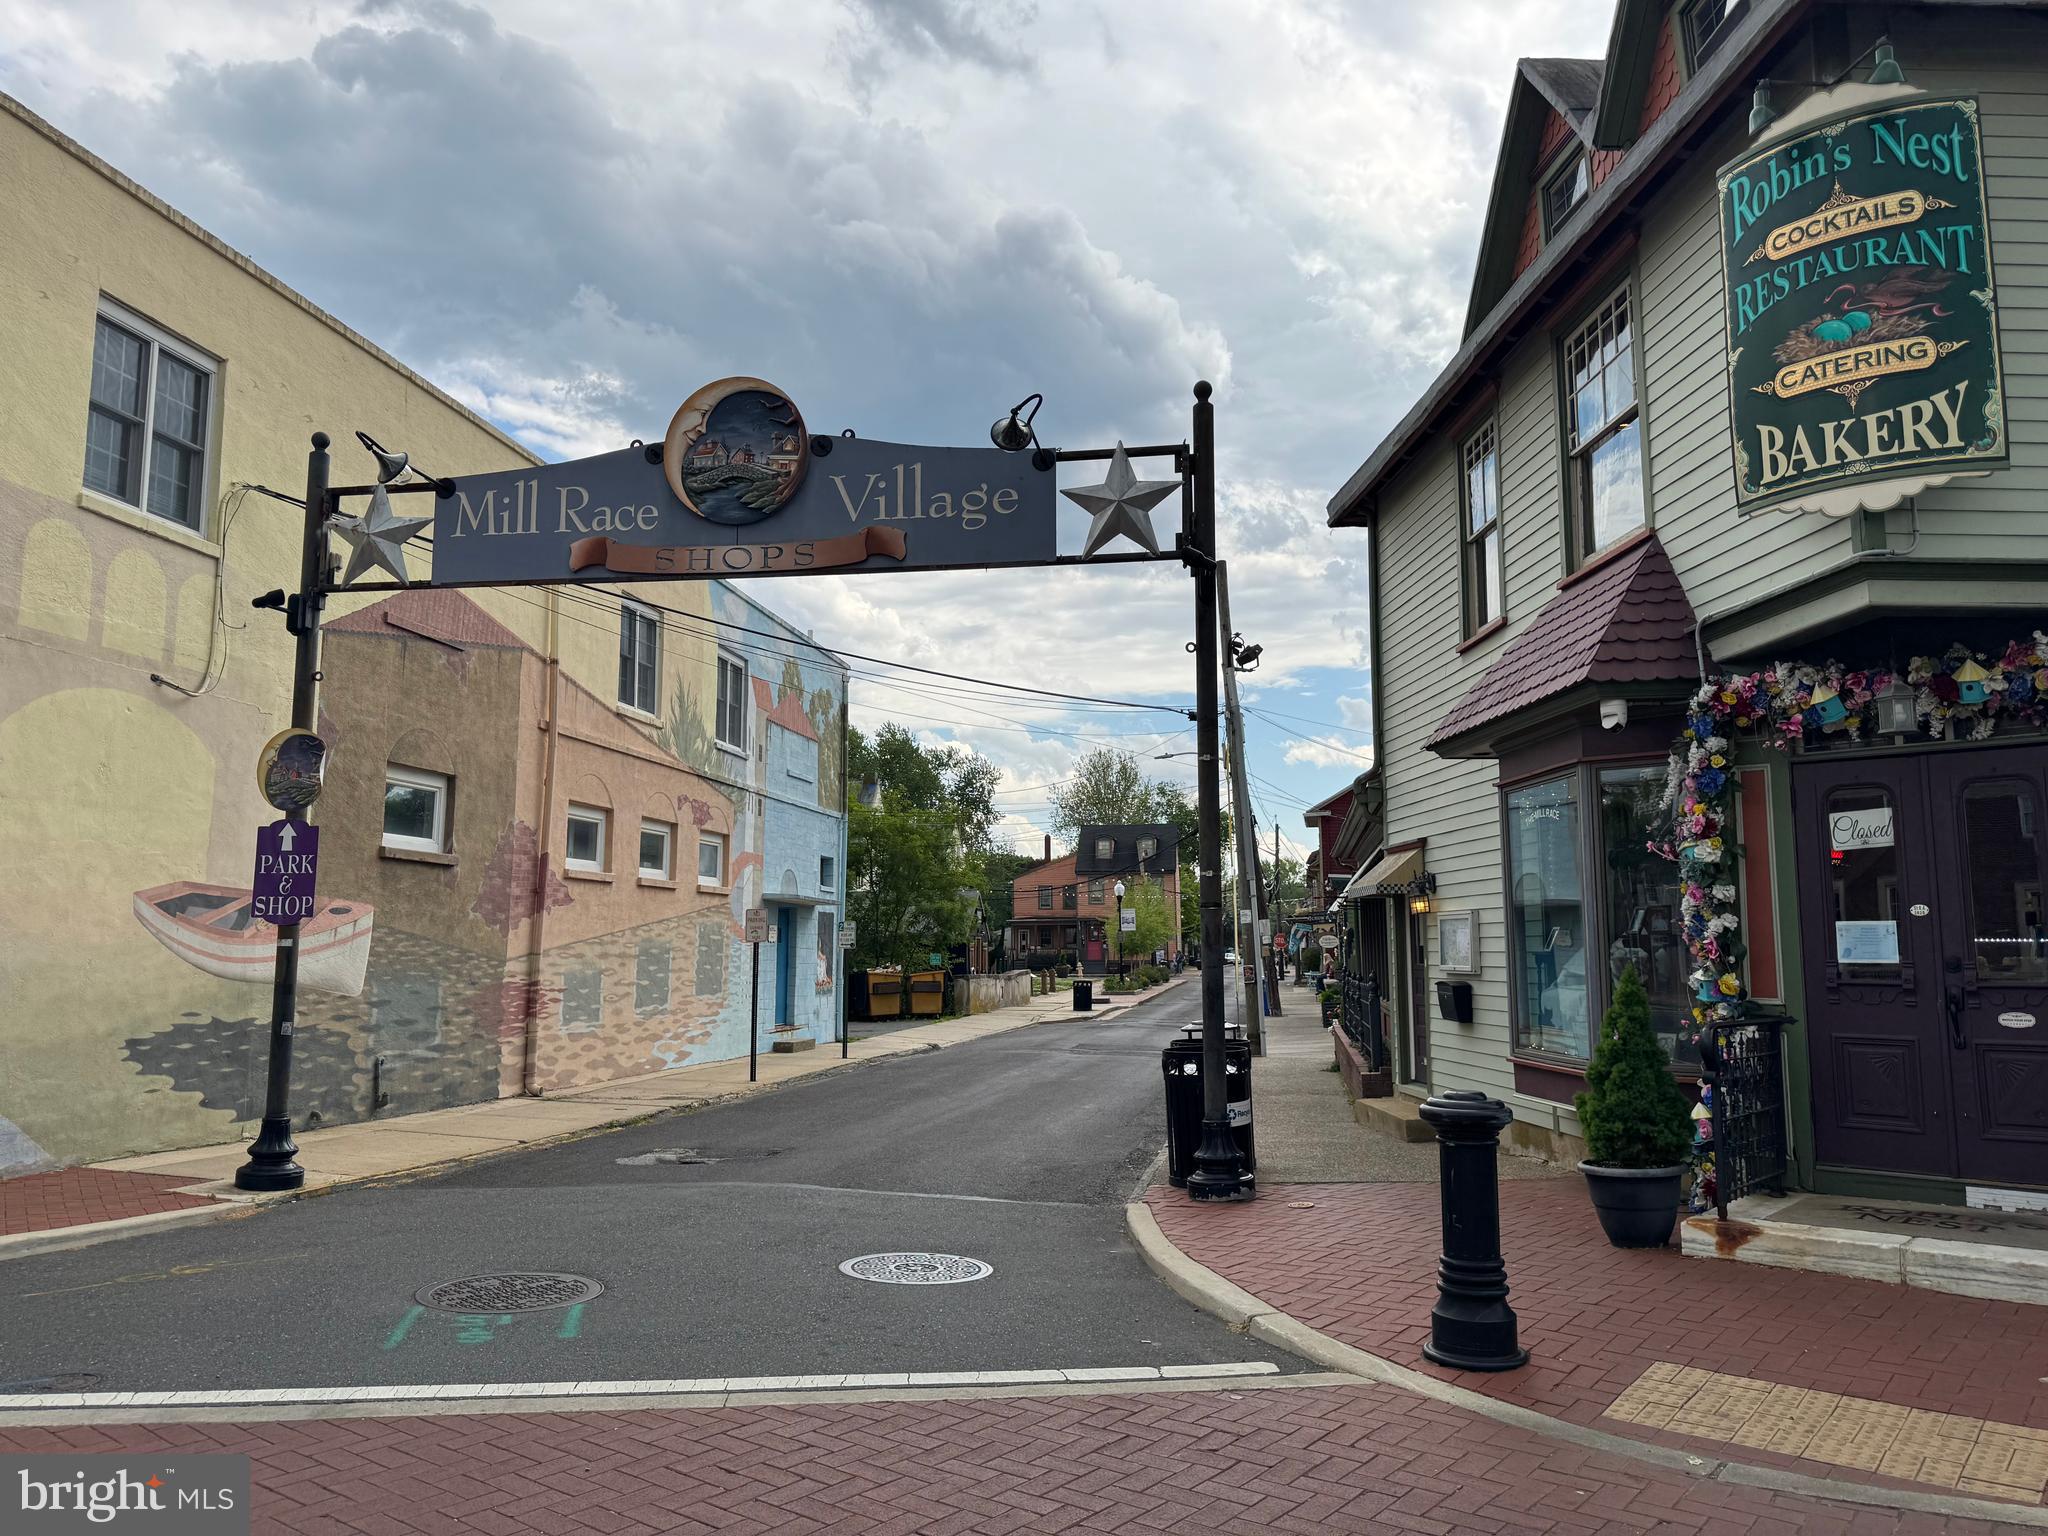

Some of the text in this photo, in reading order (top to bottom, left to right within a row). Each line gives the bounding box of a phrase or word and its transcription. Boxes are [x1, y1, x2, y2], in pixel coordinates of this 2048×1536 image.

[1728, 118, 1969, 248] Robin's Nest
[1772, 196, 1917, 252] COCKTAILS
[1734, 224, 1975, 337] RESTAURANT
[1780, 339, 1929, 388] CATERING
[1756, 380, 1969, 486] BAKERY
[450, 463, 1019, 537] Mill Race Village
[655, 543, 816, 572] SHOPS
[1832, 816, 1893, 844] Closed
[259, 854, 315, 874] PARK
[279, 876, 293, 894] &
[254, 896, 314, 917] SHOP
[1857, 1212, 2005, 1233] NEST
